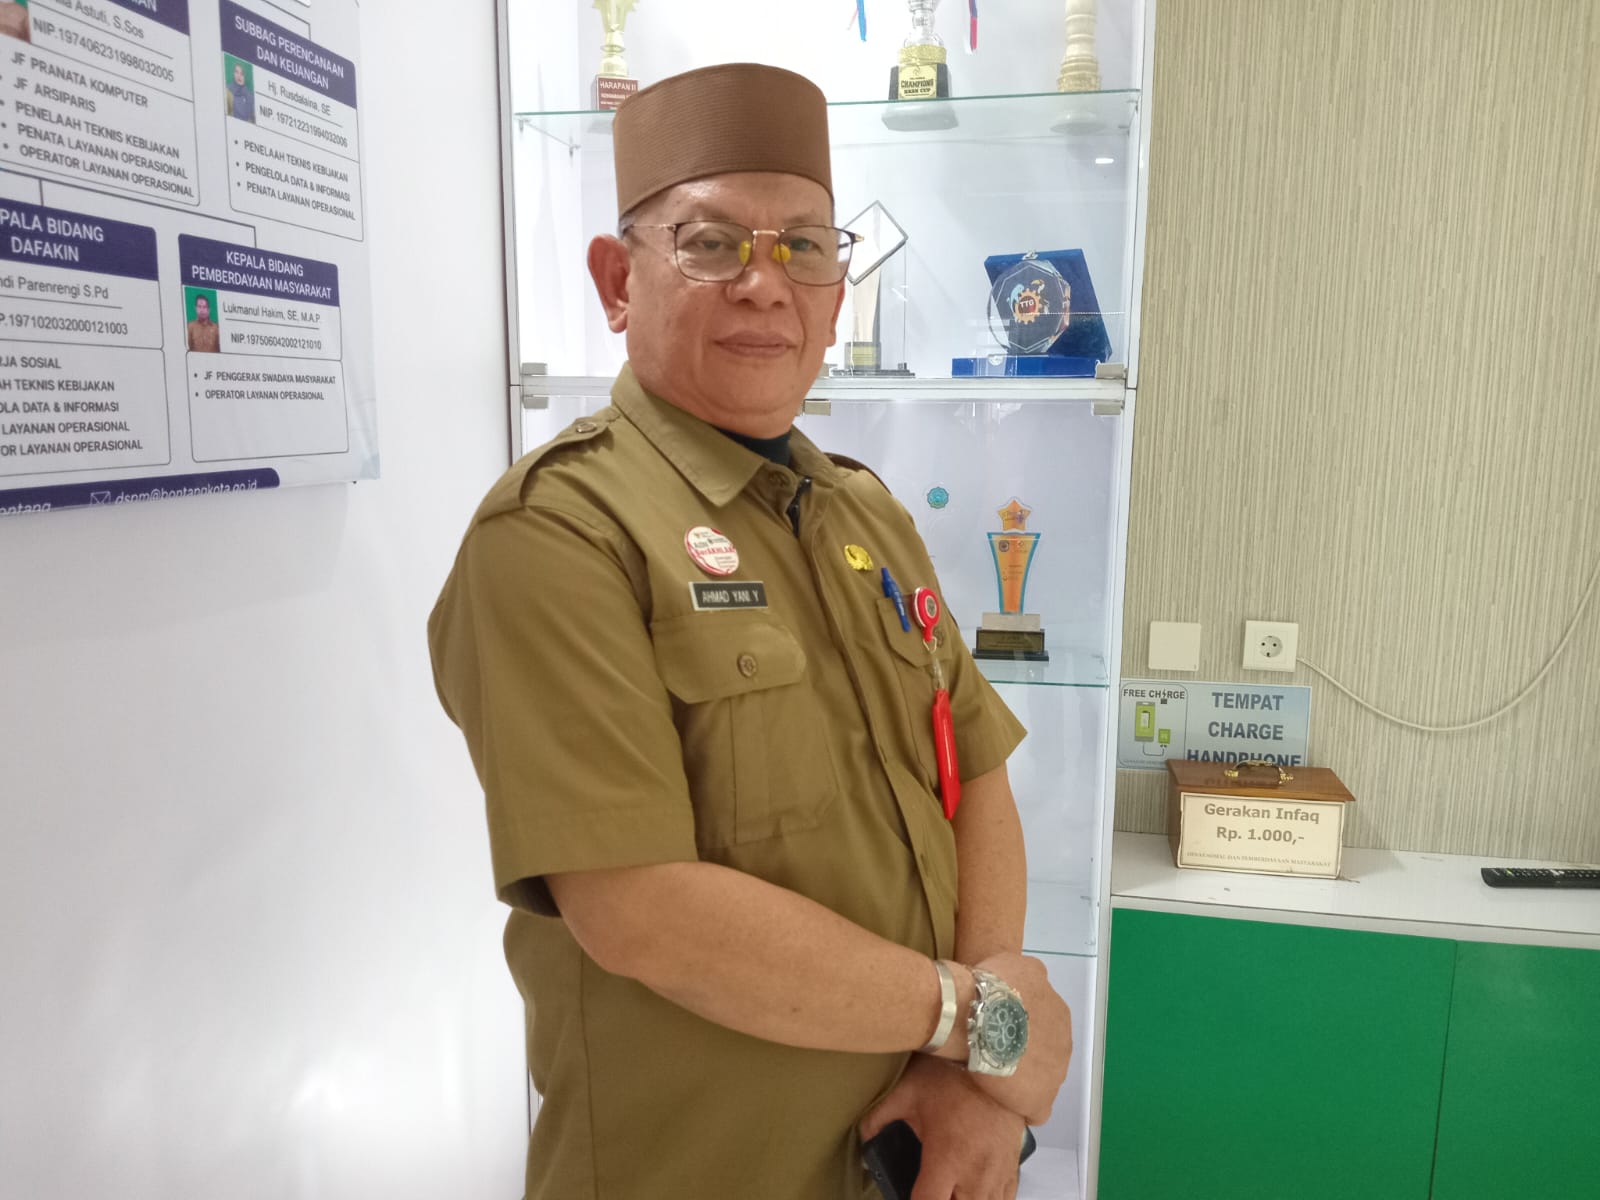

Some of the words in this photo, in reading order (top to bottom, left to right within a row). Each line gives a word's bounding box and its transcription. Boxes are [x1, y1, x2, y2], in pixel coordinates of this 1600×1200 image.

[113, 16, 144, 38] S.Sos
[235, 16, 276, 46] SUBBAG
[279, 36, 344, 78] PERENCANAAN
[257, 45, 278, 67] DAN
[280, 57, 329, 90] KEUANGAN
[11, 52, 25, 65] JF
[30, 57, 87, 88] PRANATA
[90, 78, 148, 108] KOMPUTER
[600, 81, 630, 91] HARAPAN
[14, 77, 28, 90] JF
[34, 83, 96, 112] ARSIPARIS
[16, 101, 81, 131] PENELAAH
[84, 121, 123, 143] TEKNIS
[126, 134, 179, 159] KEBIJAKAN
[17, 123, 64, 146] PENATA
[68, 137, 118, 161] LAYANAN
[121, 152, 188, 179] OPERASIONAL
[244, 140, 285, 162] PENELAAH
[286, 153, 312, 170] TEKNIS
[312, 163, 348, 182] KEBIJAKAN
[20, 144, 80, 169] OPERATOR
[83, 160, 129, 182] LAYANAN
[132, 173, 194, 198] OPERASIONAL
[245, 161, 289, 184] PENGELOLA
[290, 175, 308, 189] DATA
[309, 181, 315, 191] &
[316, 183, 351, 202] INFORMASI
[247, 181, 276, 199] PENATA
[278, 191, 310, 208] LAYANAN
[312, 200, 356, 221] OPERASIONAL
[47, 217, 104, 242] BIDANG
[11, 236, 79, 262] DAFAKIN
[226, 250, 266, 271] KEPALA
[268, 259, 304, 277] BIDANG
[18, 276, 80, 299] Parenrengi
[83, 284, 109, 299] S.Pd
[191, 265, 273, 290] PEMBERDAYAAN
[274, 279, 332, 299] MASYARAKAT
[223, 302, 260, 316] Lukmanul
[20, 356, 62, 369] SOSIAL
[14, 379, 55, 391] TEKNIS
[58, 380, 115, 392] KEBIJAKAN
[204, 371, 212, 380] JF
[216, 372, 261, 382] PENGGERAK
[262, 373, 294, 383] SWADAYA
[295, 374, 336, 384] MASYARAKAT
[205, 389, 245, 399] OPERATOR
[246, 390, 279, 400] LAYANAN
[280, 391, 324, 400] OPERASIONAL
[22, 402, 50, 413] DATA
[53, 402, 61, 413] &
[64, 401, 120, 412] INFORMASI
[2, 423, 55, 435] LAYANAN
[58, 421, 130, 433] OPERASIONAL
[20, 442, 71, 455] LAYANAN
[73, 440, 144, 453] OPERASIONAL
[702, 589, 730, 603] AHMAD
[752, 589, 759, 603] Y
[1123, 689, 1146, 697] FREE
[1212, 692, 1284, 711] TEMPAT
[1208, 721, 1284, 740] CHARGE
[1204, 803, 1270, 819] Gerakan
[1275, 807, 1320, 824] Infaq
[1217, 827, 1241, 841] Rp.
[1248, 828, 1304, 845] 1.000,-
